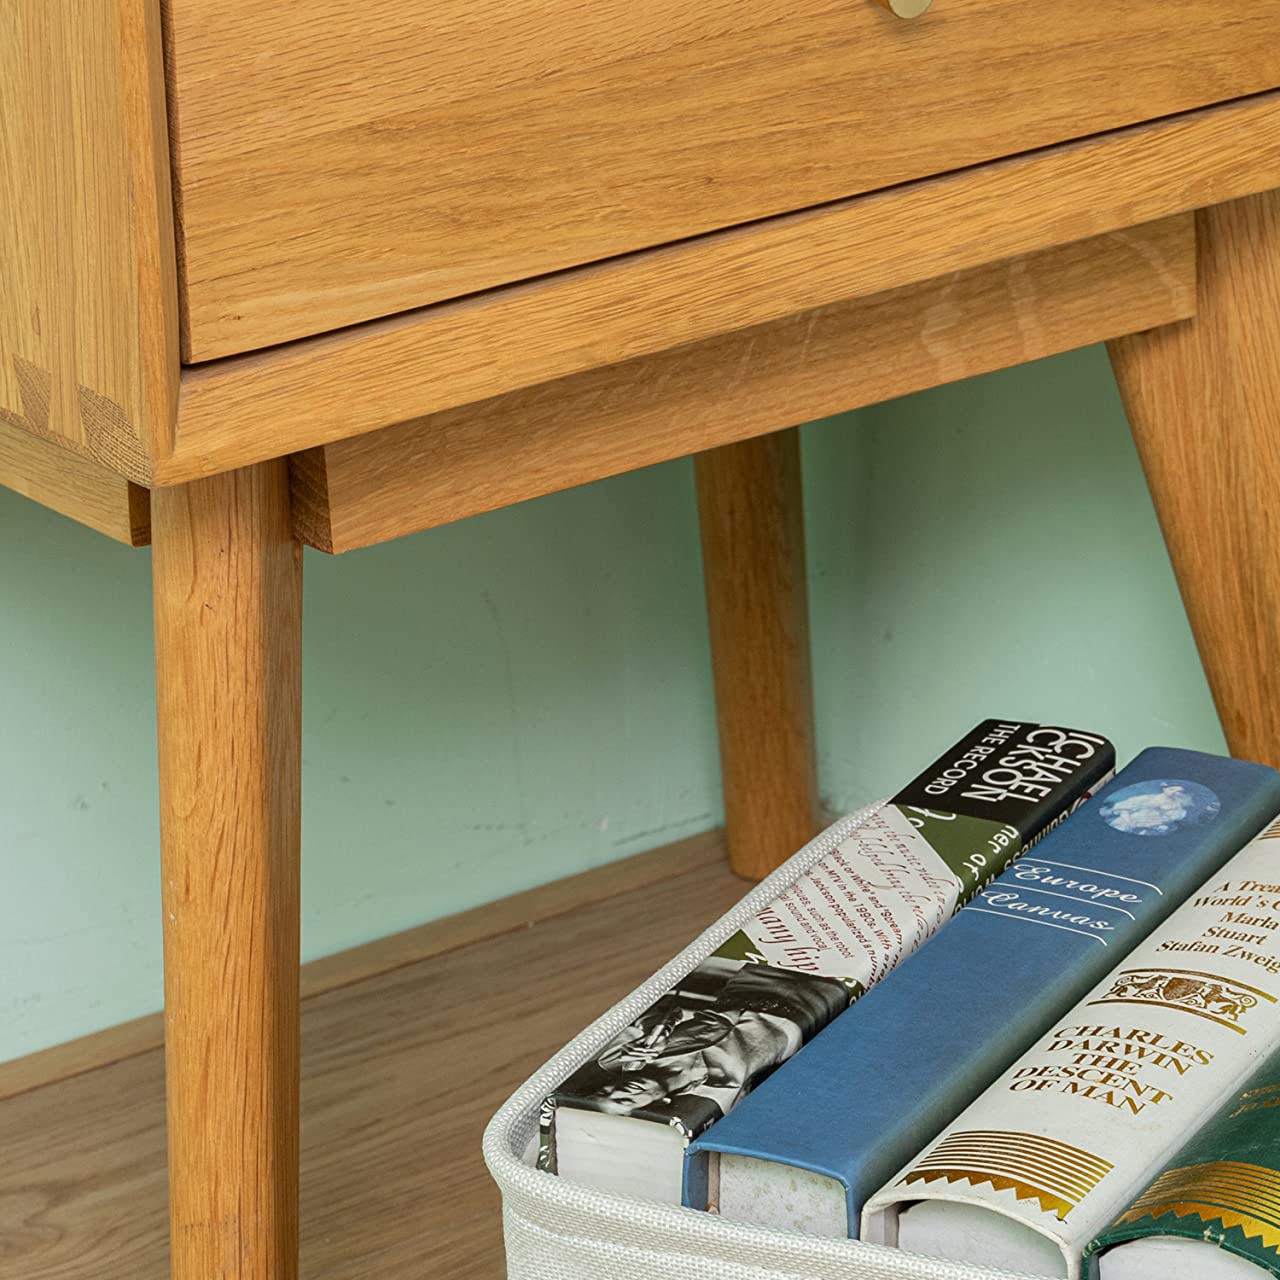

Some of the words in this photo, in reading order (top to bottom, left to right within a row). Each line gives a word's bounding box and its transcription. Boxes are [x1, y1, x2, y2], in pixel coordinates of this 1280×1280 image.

[981, 723, 1021, 746] THE
[924, 745, 996, 795] RECORD
[1013, 864, 1143, 903] Europe
[1213, 881, 1231, 893] A
[980, 890, 1115, 931] Canvas
[1218, 911, 1280, 931] Marla
[1155, 940, 1221, 954] Stafan
[1201, 926, 1269, 946] Stuart
[1047, 1039, 1193, 1076] DARWIN
[1053, 1025, 1215, 1067] CHARLES
[1070, 1053, 1143, 1077] THE
[1008, 1079, 1061, 1093] OF
[1061, 1081, 1148, 1116] MAN
[1012, 1065, 1174, 1106] DESCENT
